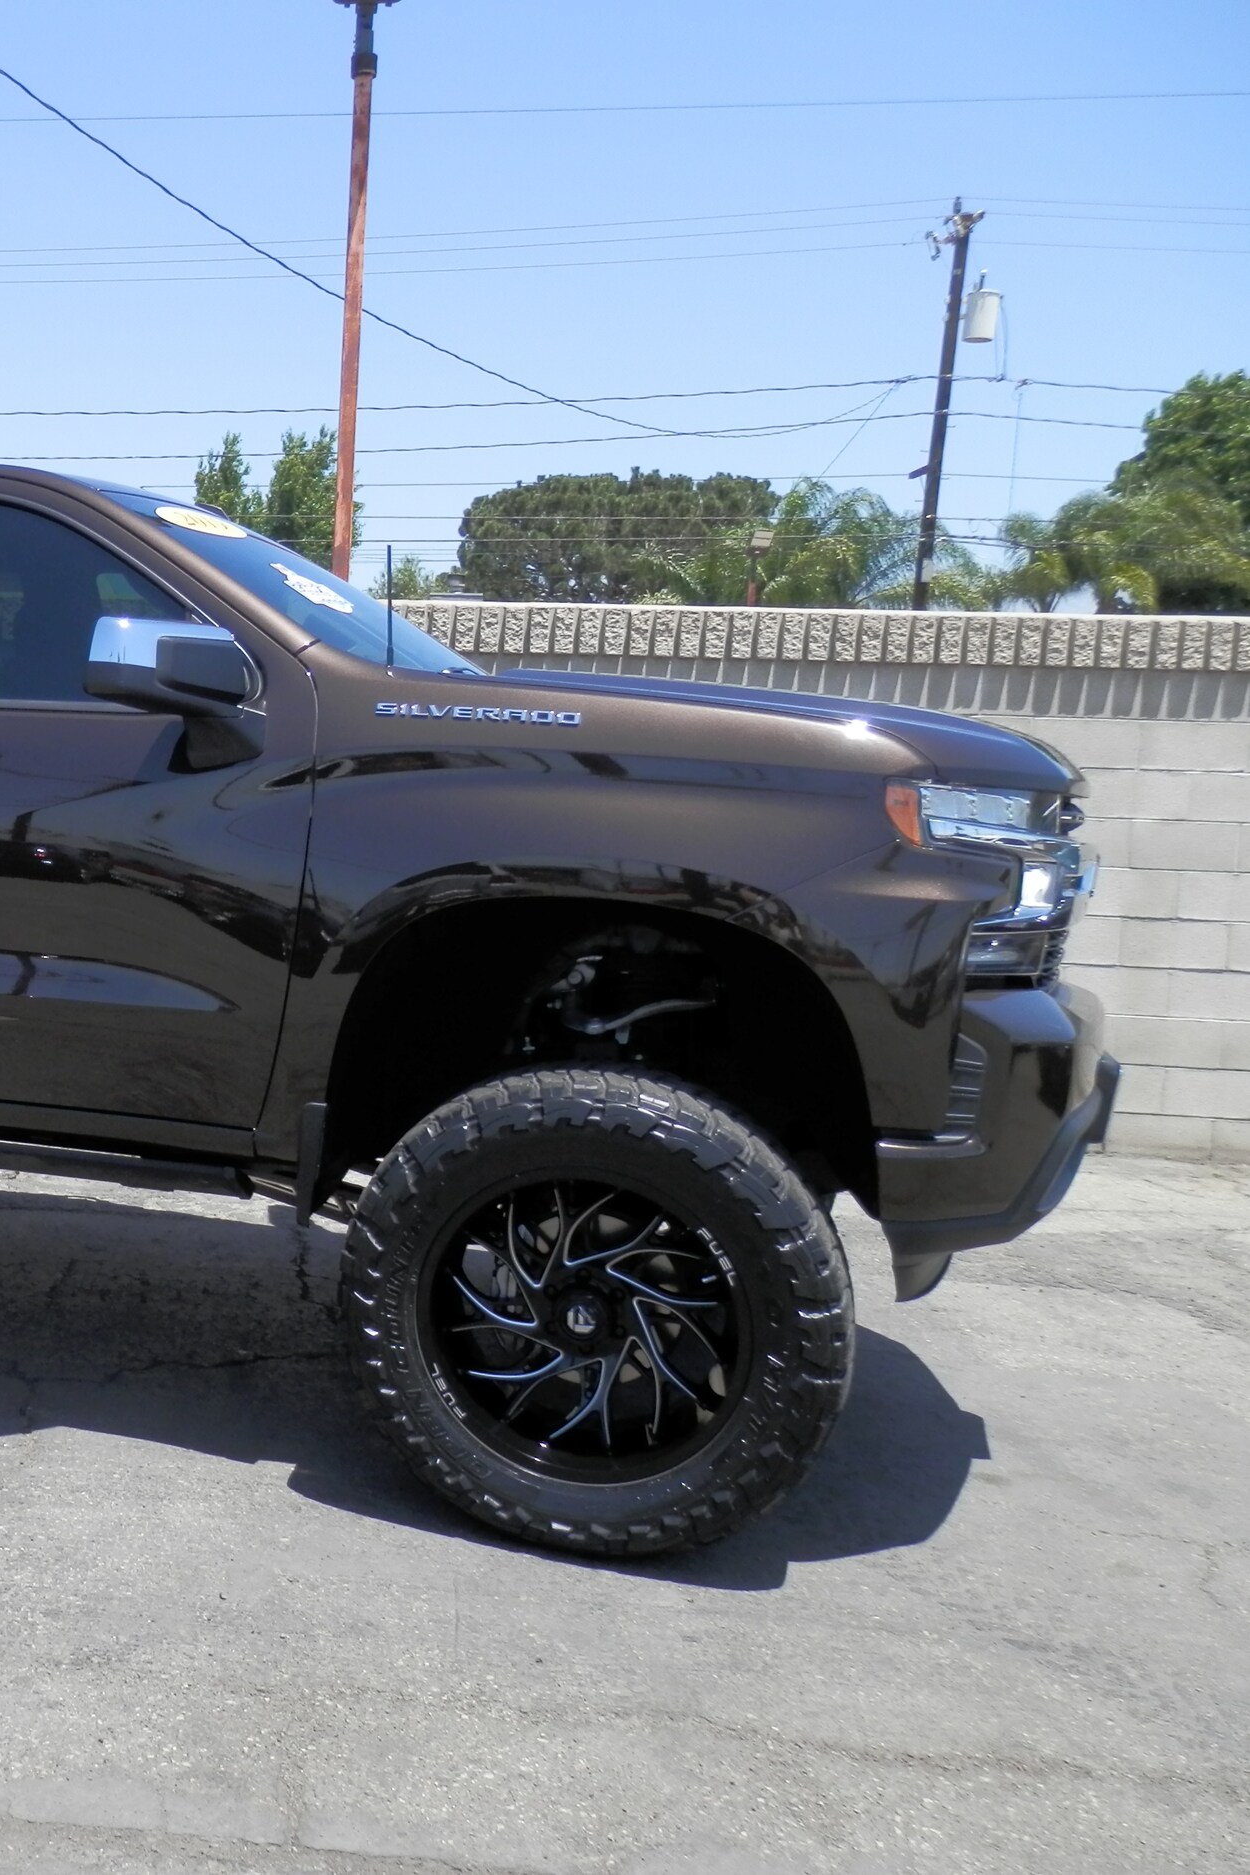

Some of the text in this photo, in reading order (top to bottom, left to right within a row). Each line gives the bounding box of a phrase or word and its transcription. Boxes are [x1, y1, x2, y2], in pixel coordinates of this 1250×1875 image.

[374, 702, 582, 726] SILVERADO
[695, 1226, 738, 1287] FUEL
[383, 1205, 423, 1375] COUNT
[431, 1362, 468, 1420] FUEL
